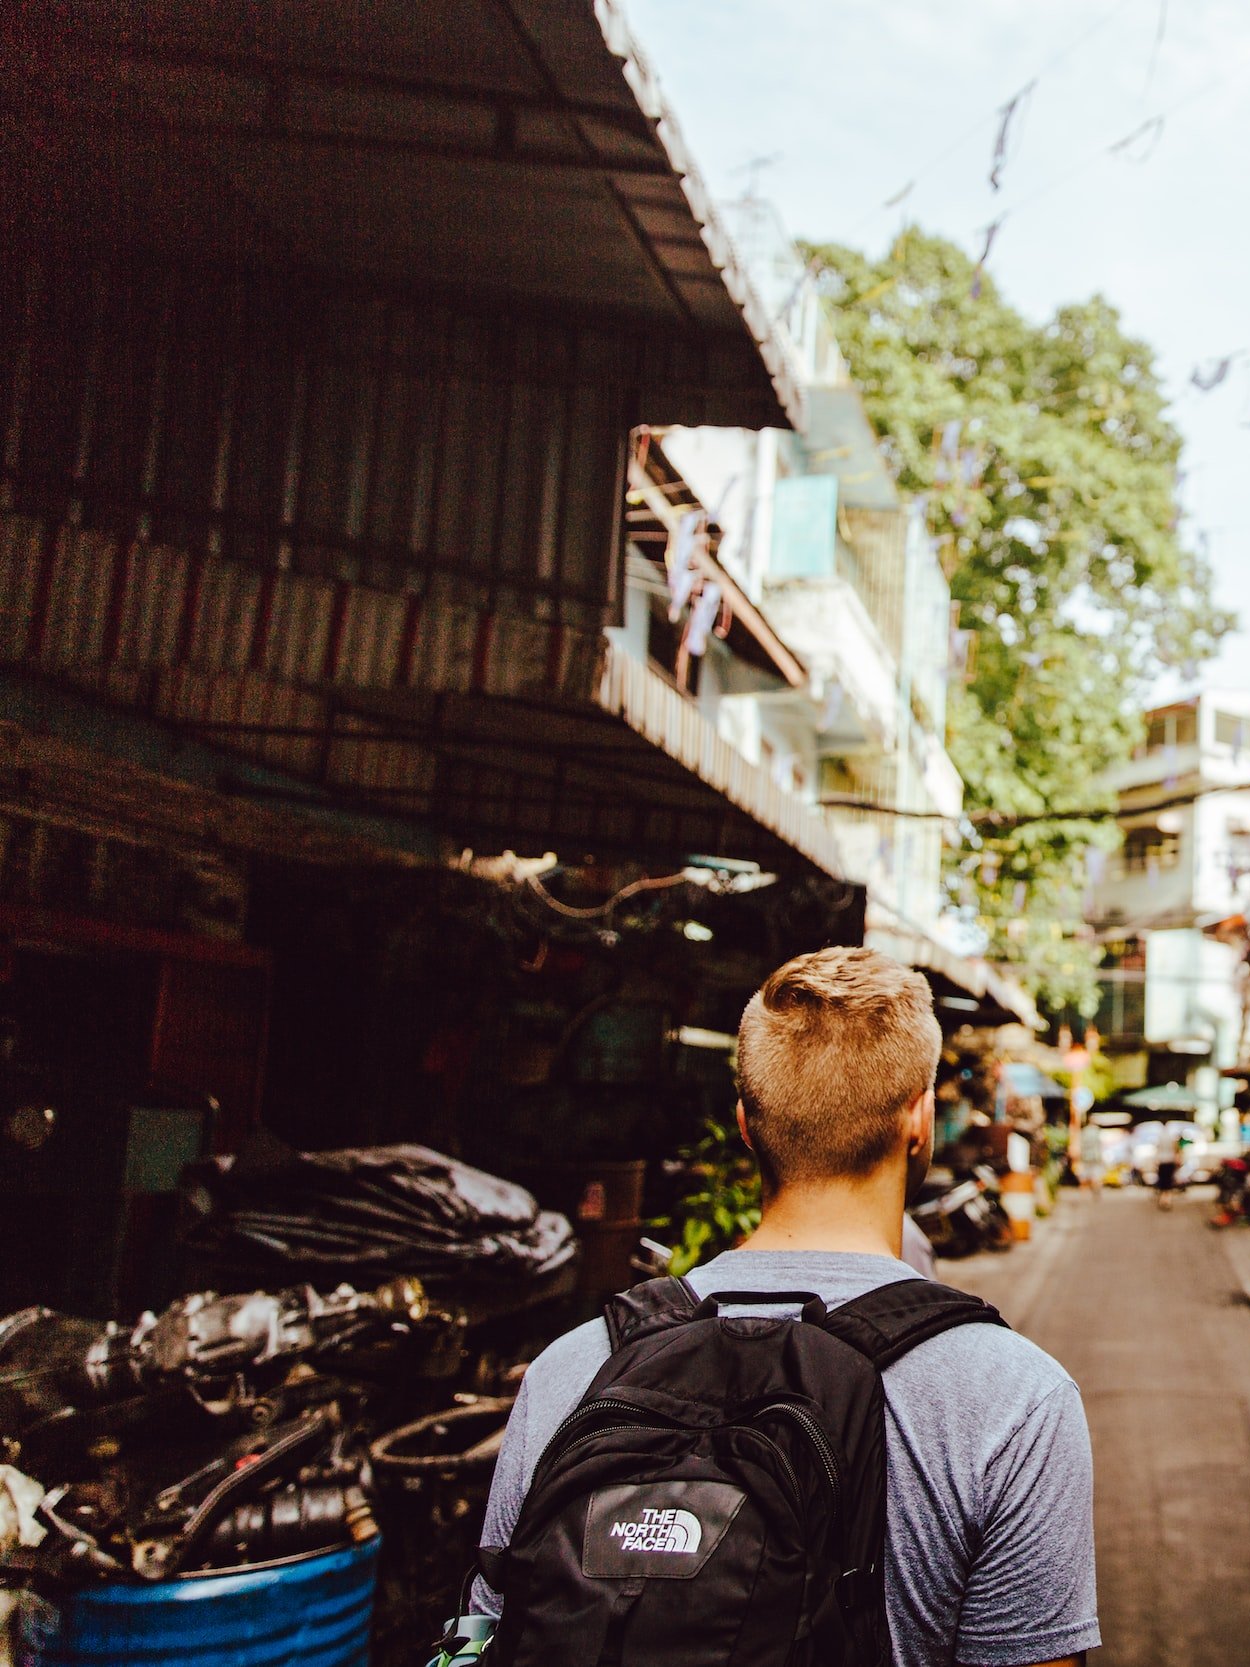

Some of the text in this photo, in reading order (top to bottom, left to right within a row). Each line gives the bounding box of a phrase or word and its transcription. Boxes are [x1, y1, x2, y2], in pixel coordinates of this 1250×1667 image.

[642, 1508, 676, 1524] THE
[610, 1522, 671, 1537] NORTH
[621, 1537, 666, 1551] FACE
